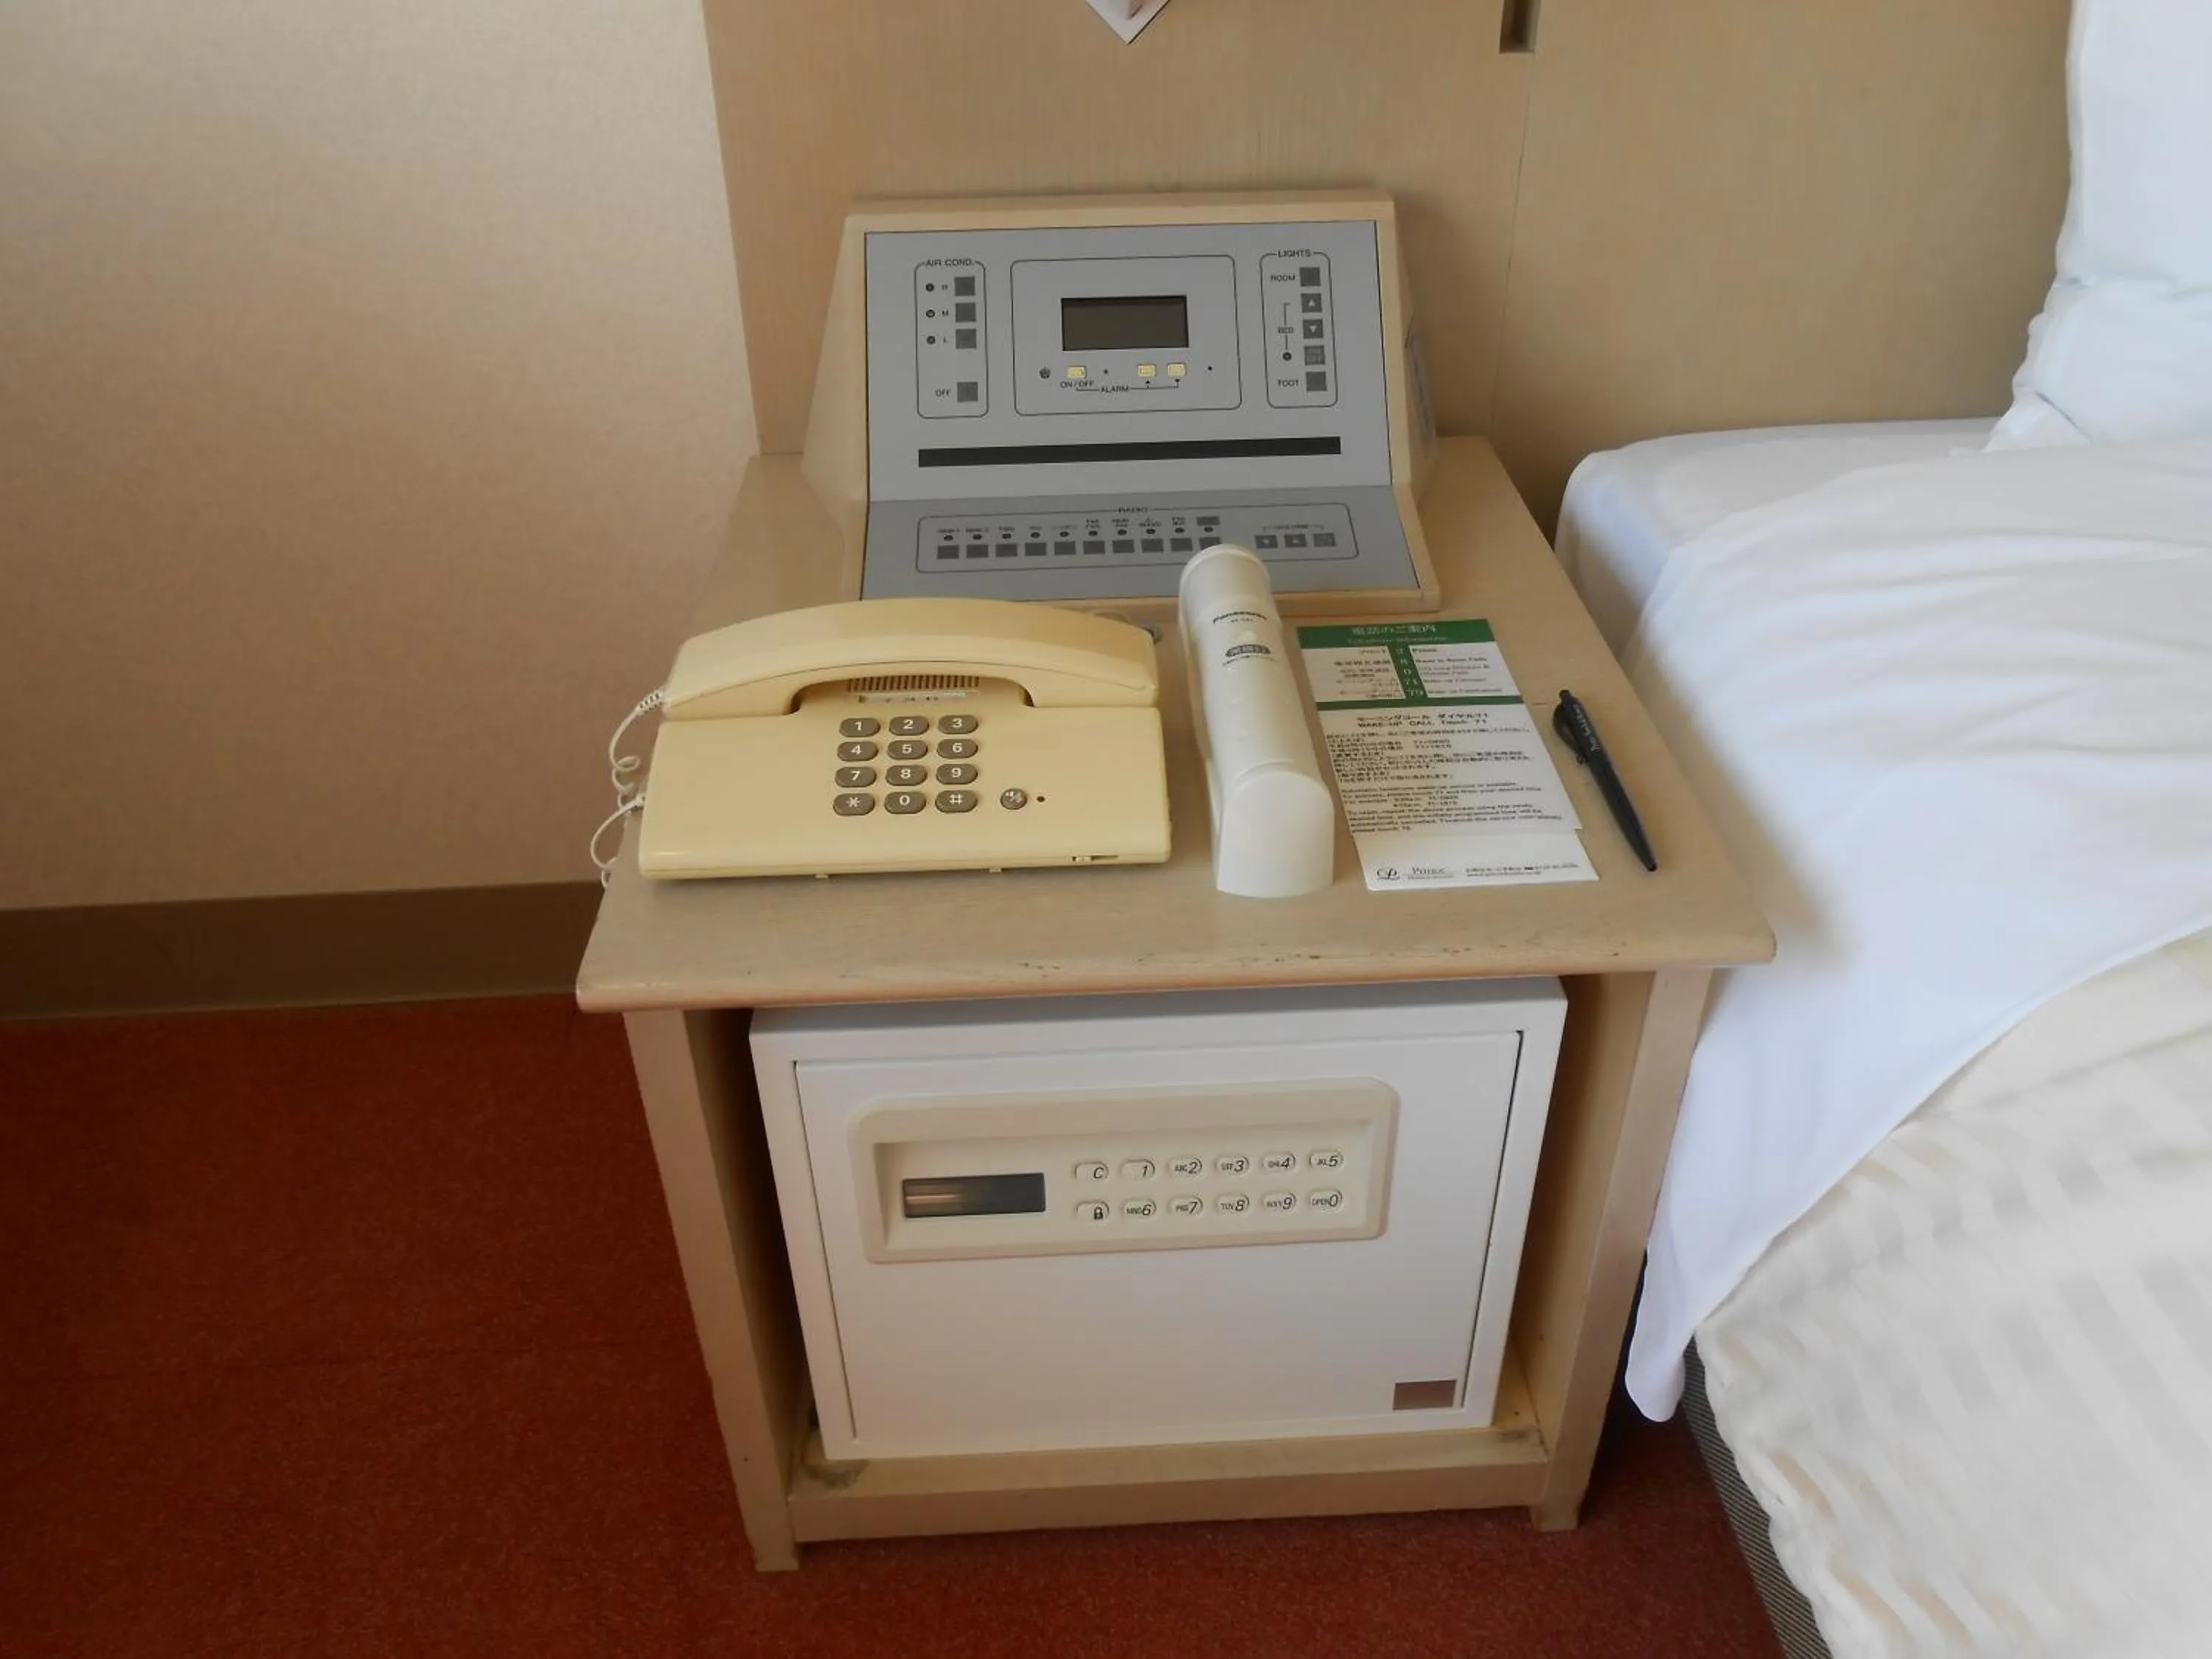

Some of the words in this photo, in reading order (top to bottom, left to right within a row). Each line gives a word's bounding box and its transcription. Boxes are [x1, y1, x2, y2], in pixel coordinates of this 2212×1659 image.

[1278, 249, 1311, 257] LIGHTS
[926, 259, 941, 267] AIR
[1270, 274, 1295, 282] ROOM
[1100, 385, 1129, 393] ALARM
[855, 721, 863, 731] 1
[903, 719, 914, 729] 2
[953, 718, 962, 728] 3
[851, 745, 862, 755] 4
[902, 744, 912, 754] 5
[953, 742, 962, 753] 6
[851, 771, 860, 781] 7
[900, 769, 911, 779] 8
[951, 768, 961, 778] 9
[899, 795, 910, 806] 0
[949, 793, 963, 805] #
[1234, 1159, 1245, 1172] 3
[1281, 1157, 1290, 1169] 4
[1328, 1155, 1339, 1167] 5
[1093, 1166, 1105, 1179] C
[1142, 1164, 1148, 1178] 1
[1188, 1161, 1199, 1174] 2
[1234, 1199, 1245, 1211] 8
[1282, 1197, 1293, 1210] 9
[1329, 1194, 1338, 1207] 0
[1142, 1203, 1152, 1216] 6
[1189, 1201, 1199, 1214] 7
